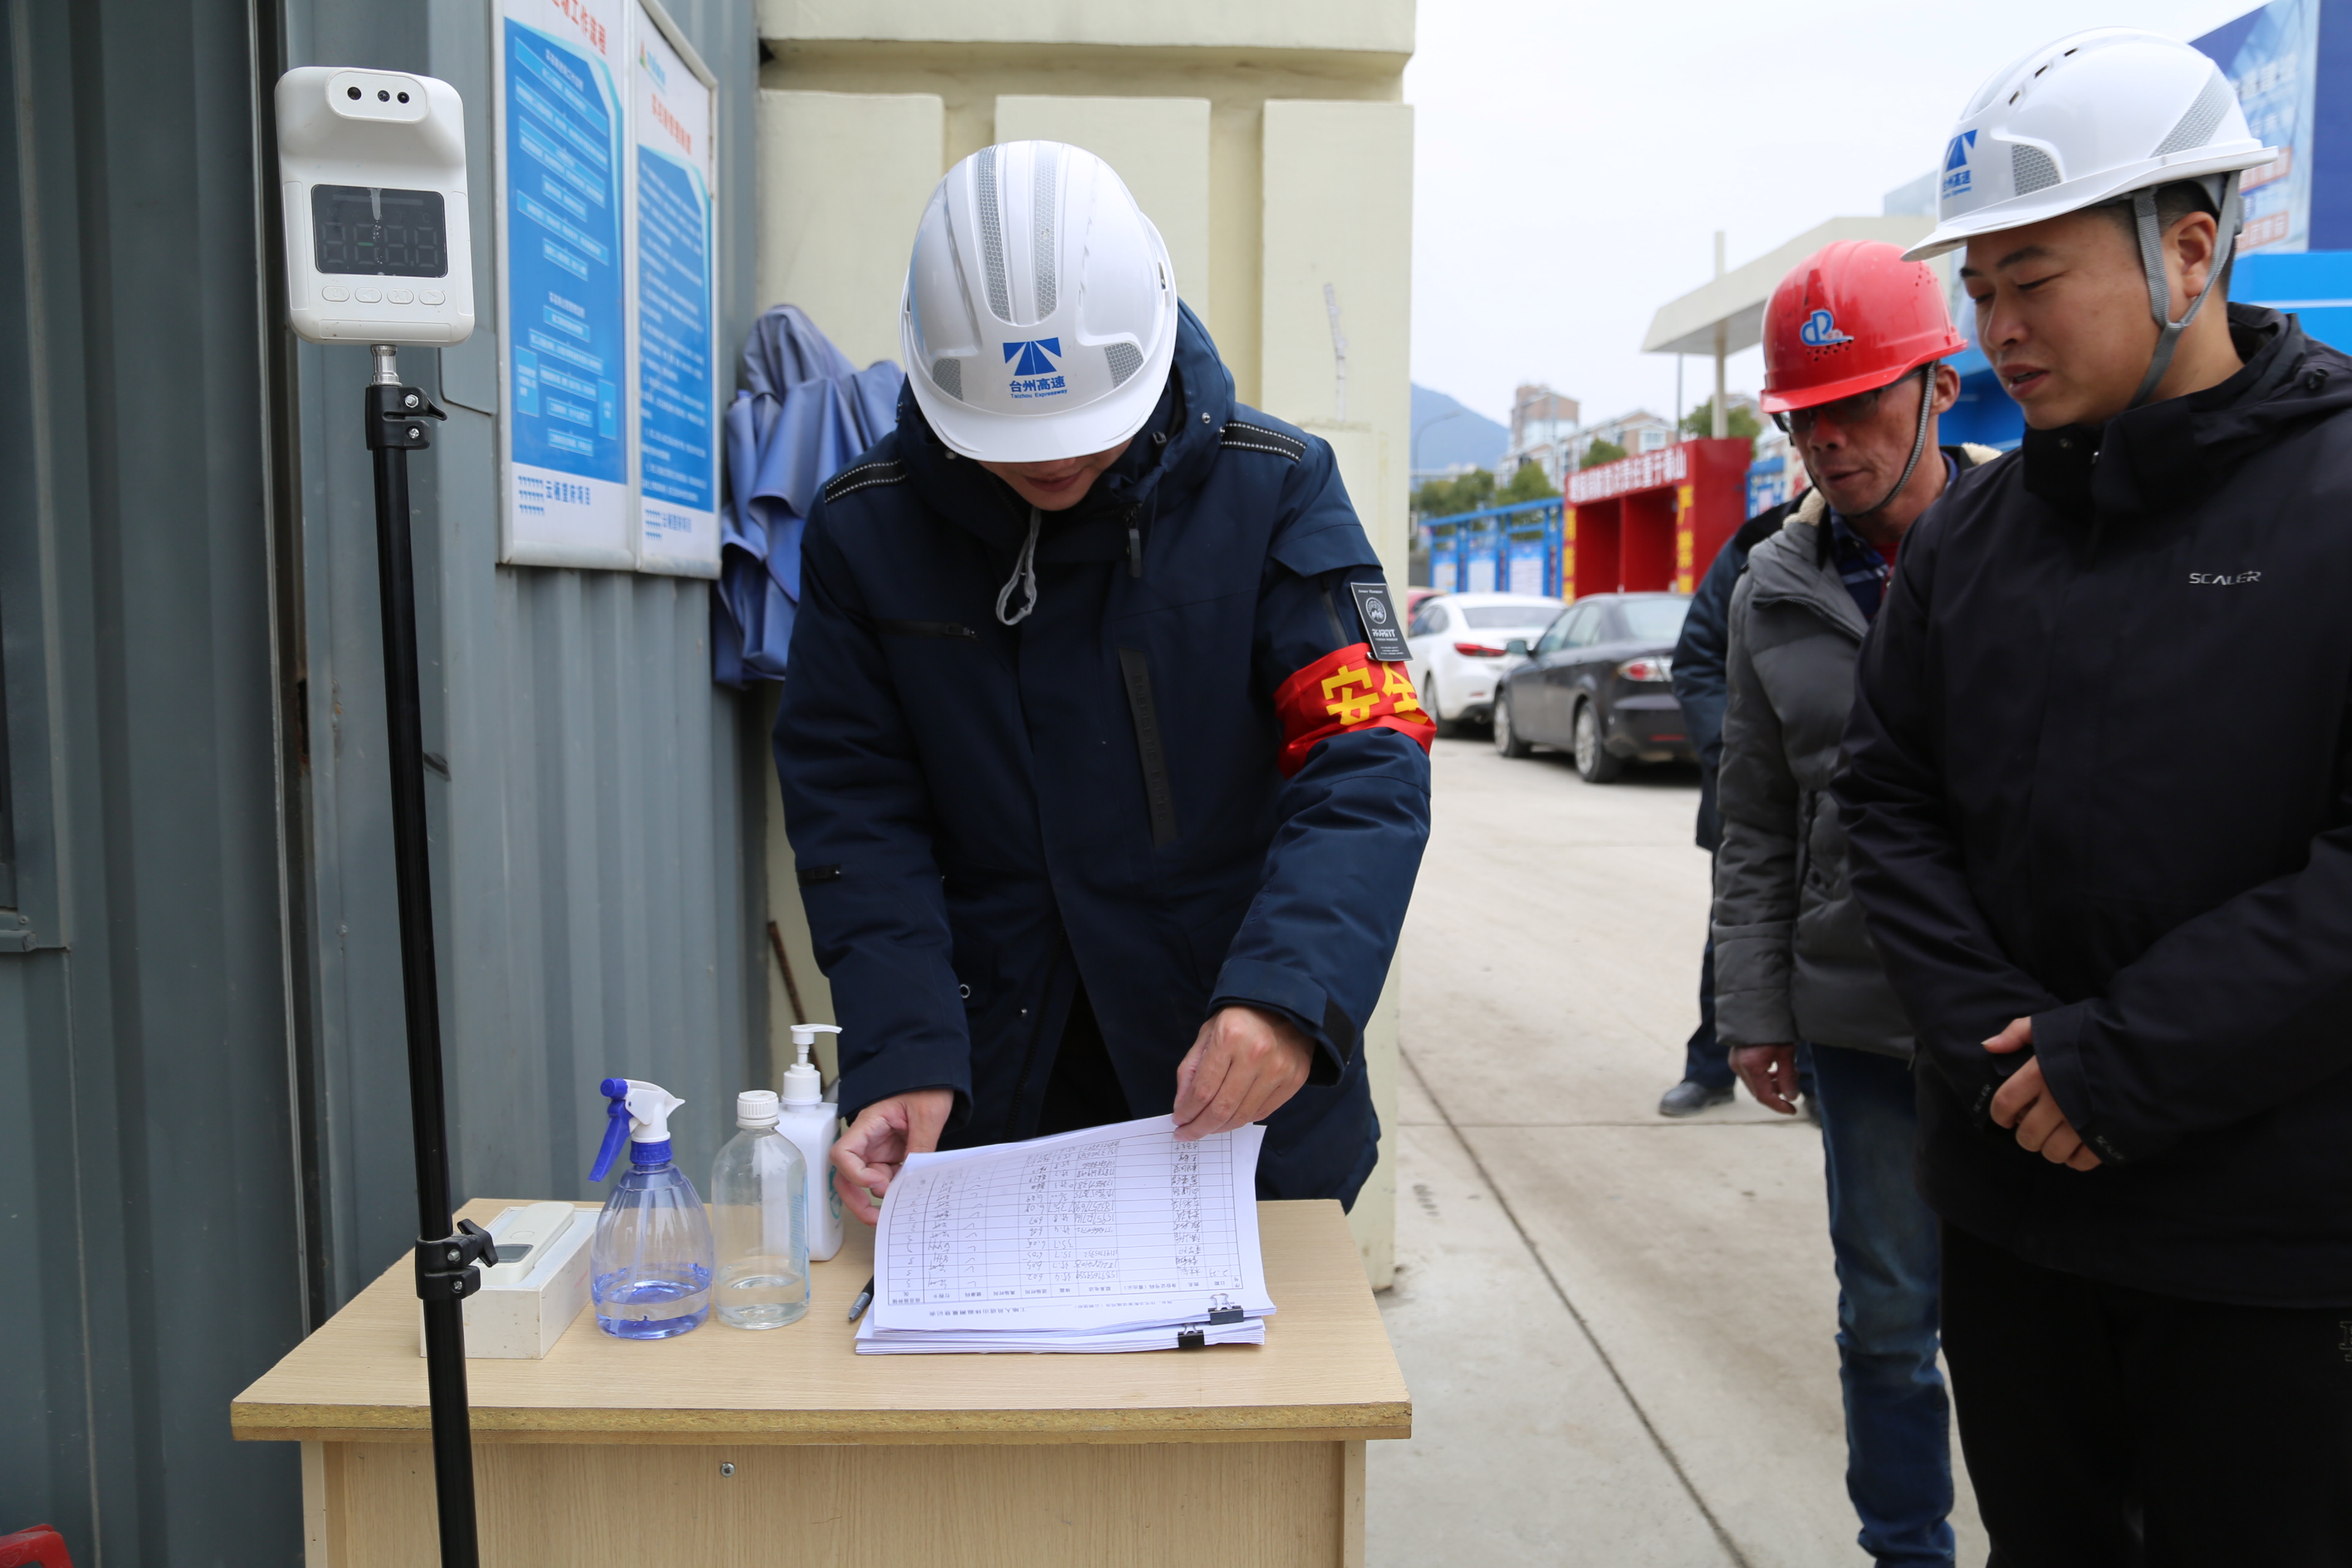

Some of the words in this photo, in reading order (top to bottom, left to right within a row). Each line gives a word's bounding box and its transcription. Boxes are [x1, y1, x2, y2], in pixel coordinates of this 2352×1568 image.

[1009, 375, 1066, 393] 台州高速
[1035, 389, 1068, 398] Expressway
[2188, 570, 2262, 586] SCALER
[1321, 661, 1430, 726] 安全
